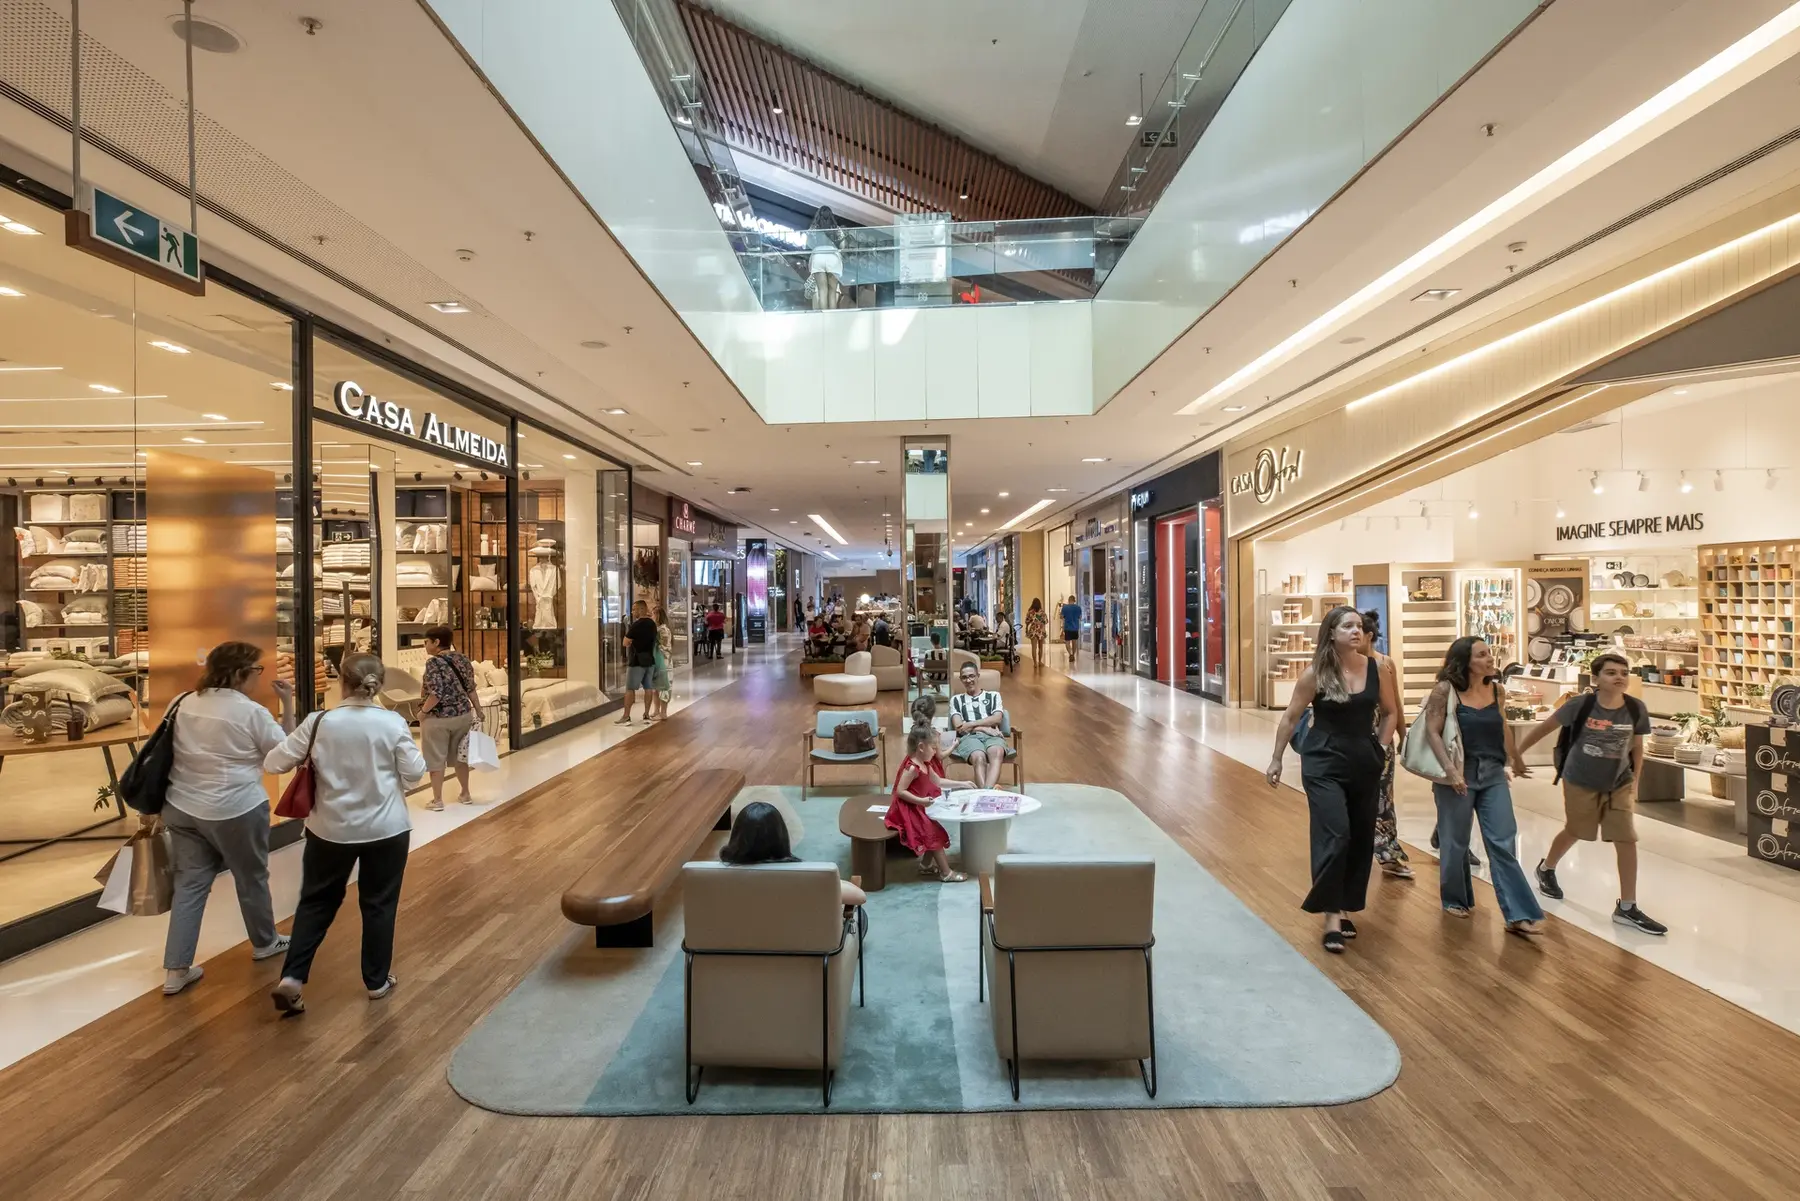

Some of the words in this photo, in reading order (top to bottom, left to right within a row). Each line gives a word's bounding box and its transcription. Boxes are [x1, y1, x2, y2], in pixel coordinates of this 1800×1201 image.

[335, 380, 416, 436] CASA
[420, 412, 508, 467] ALMEIDA
[1231, 471, 1254, 495] CASA
[675, 516, 696, 534] CHARME
[1556, 522, 1605, 541] IMAGINE
[1609, 516, 1662, 537] SEMPRE
[1666, 513, 1704, 533] MAIS
